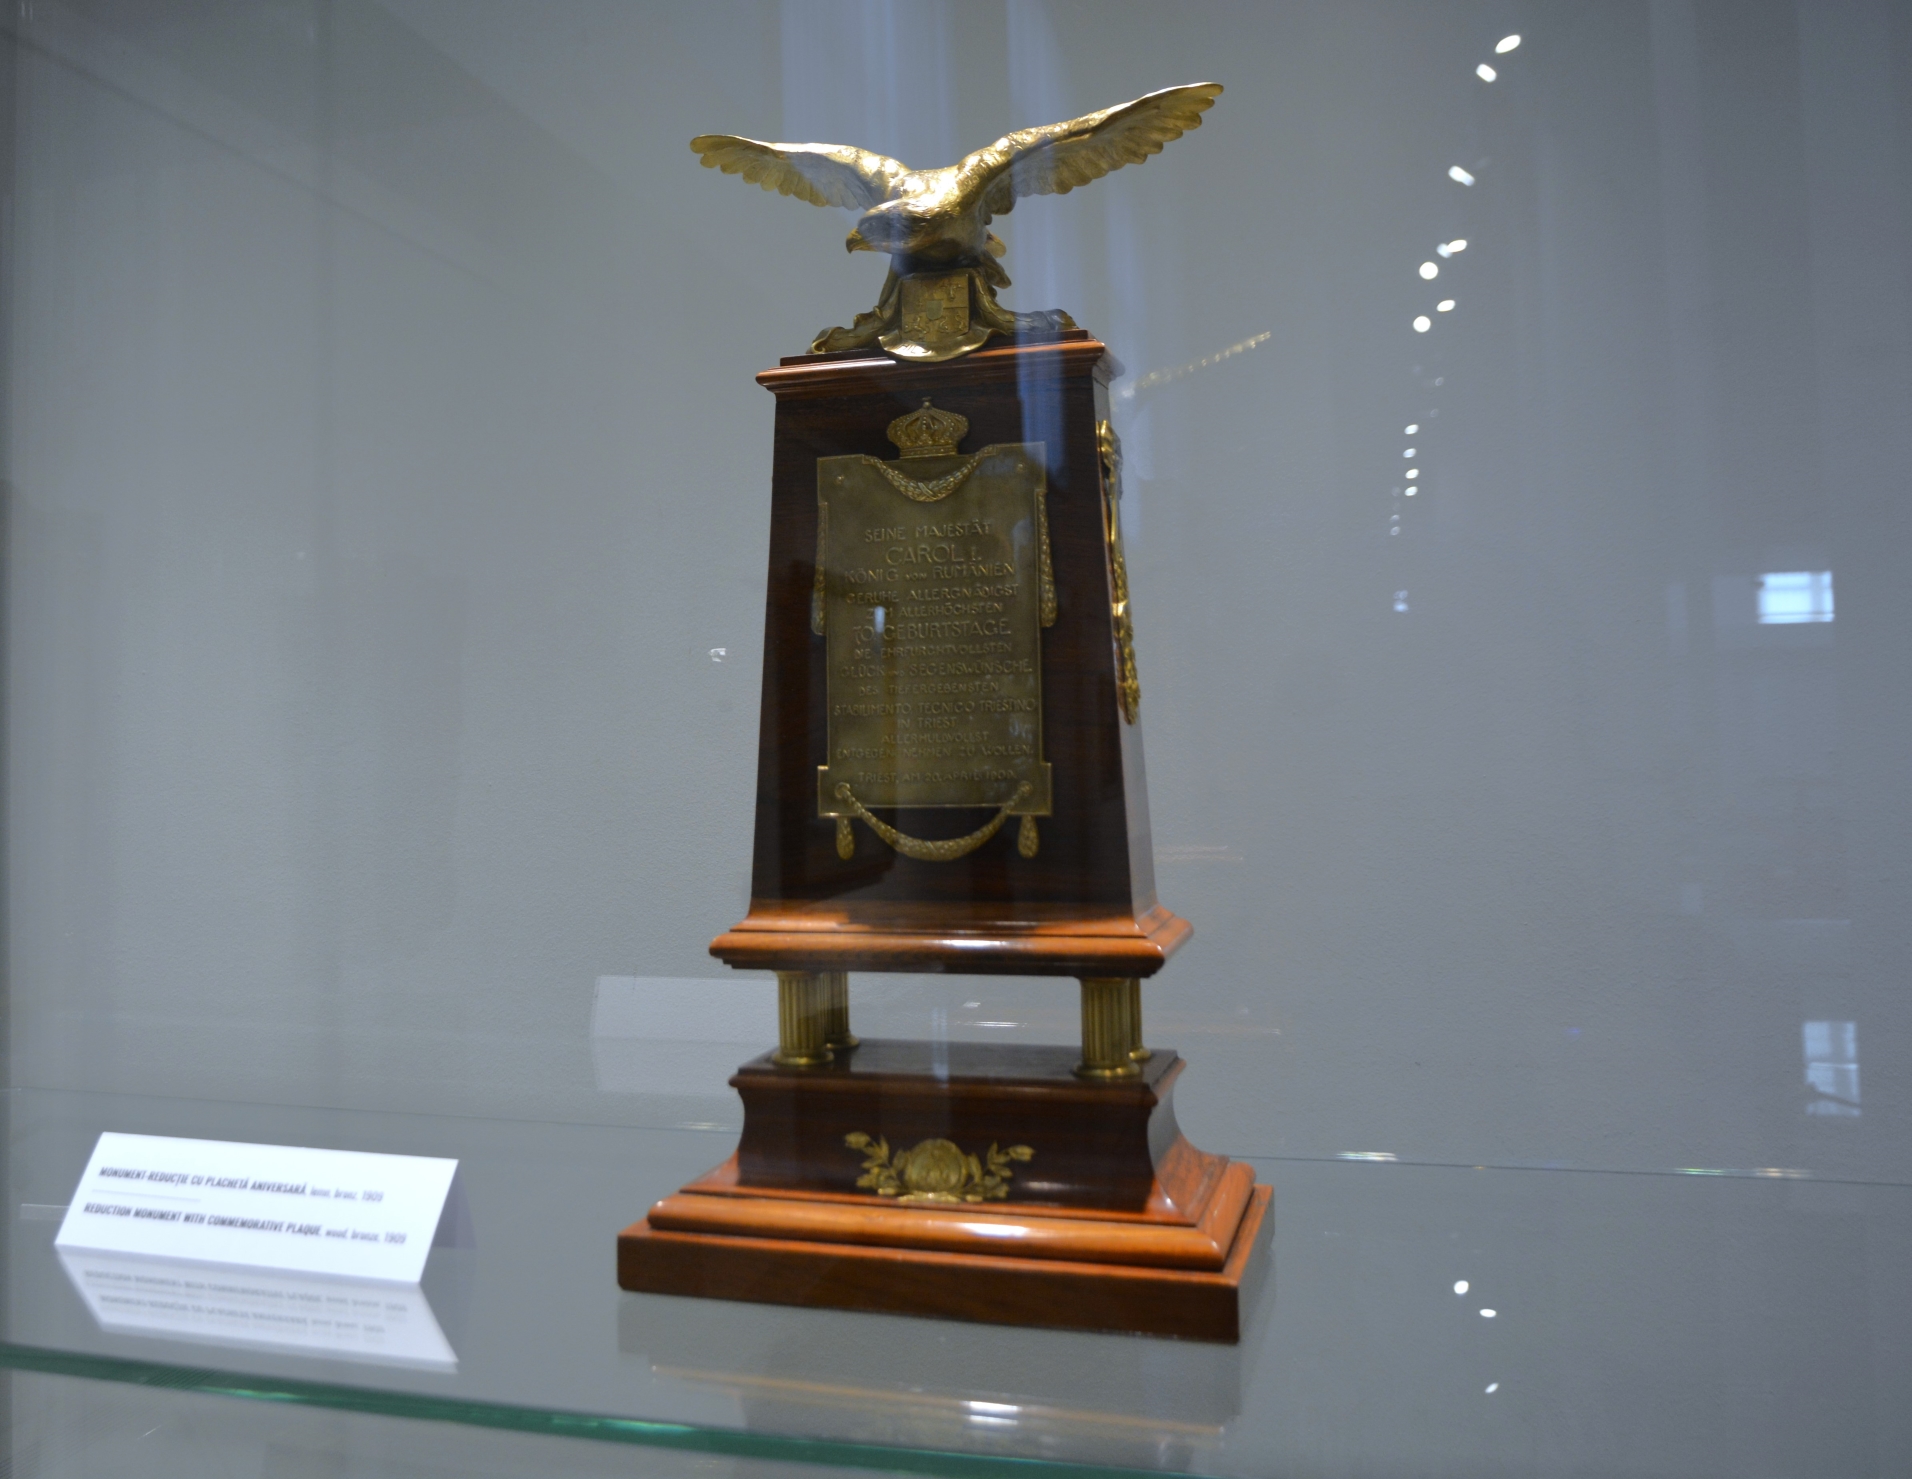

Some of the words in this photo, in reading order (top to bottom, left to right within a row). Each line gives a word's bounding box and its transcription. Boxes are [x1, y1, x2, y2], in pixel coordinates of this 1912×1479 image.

[865, 527, 905, 543] SEINE
[915, 519, 991, 538] MAJESTÄT
[886, 544, 964, 566] CAROL
[844, 567, 899, 584] KÖNIG
[933, 562, 1015, 579] RUMÄNIEN
[846, 590, 900, 604] GERUHE
[908, 583, 1019, 601] ALLERGNÄDIGST
[866, 607, 893, 620] ZM
[900, 602, 1003, 618] ALLERHÖCHSTEN
[883, 618, 1012, 641] GEBURTSTAGE
[859, 686, 879, 696] DES
[834, 703, 912, 717] STABILIMENTO
[918, 701, 975, 714] TECNICO
[979, 699, 1036, 712] TRIESTINO
[917, 716, 957, 729] TRIEST
[190, 1174, 204, 1186] CU
[361, 1190, 384, 1203] 1909
[83, 1202, 132, 1217] REDUCTION
[133, 1207, 182, 1222] MONUMENT
[183, 1212, 206, 1224] WITH
[207, 1214, 285, 1233] COMMEMORATIVE
[384, 1231, 407, 1246] 1909
